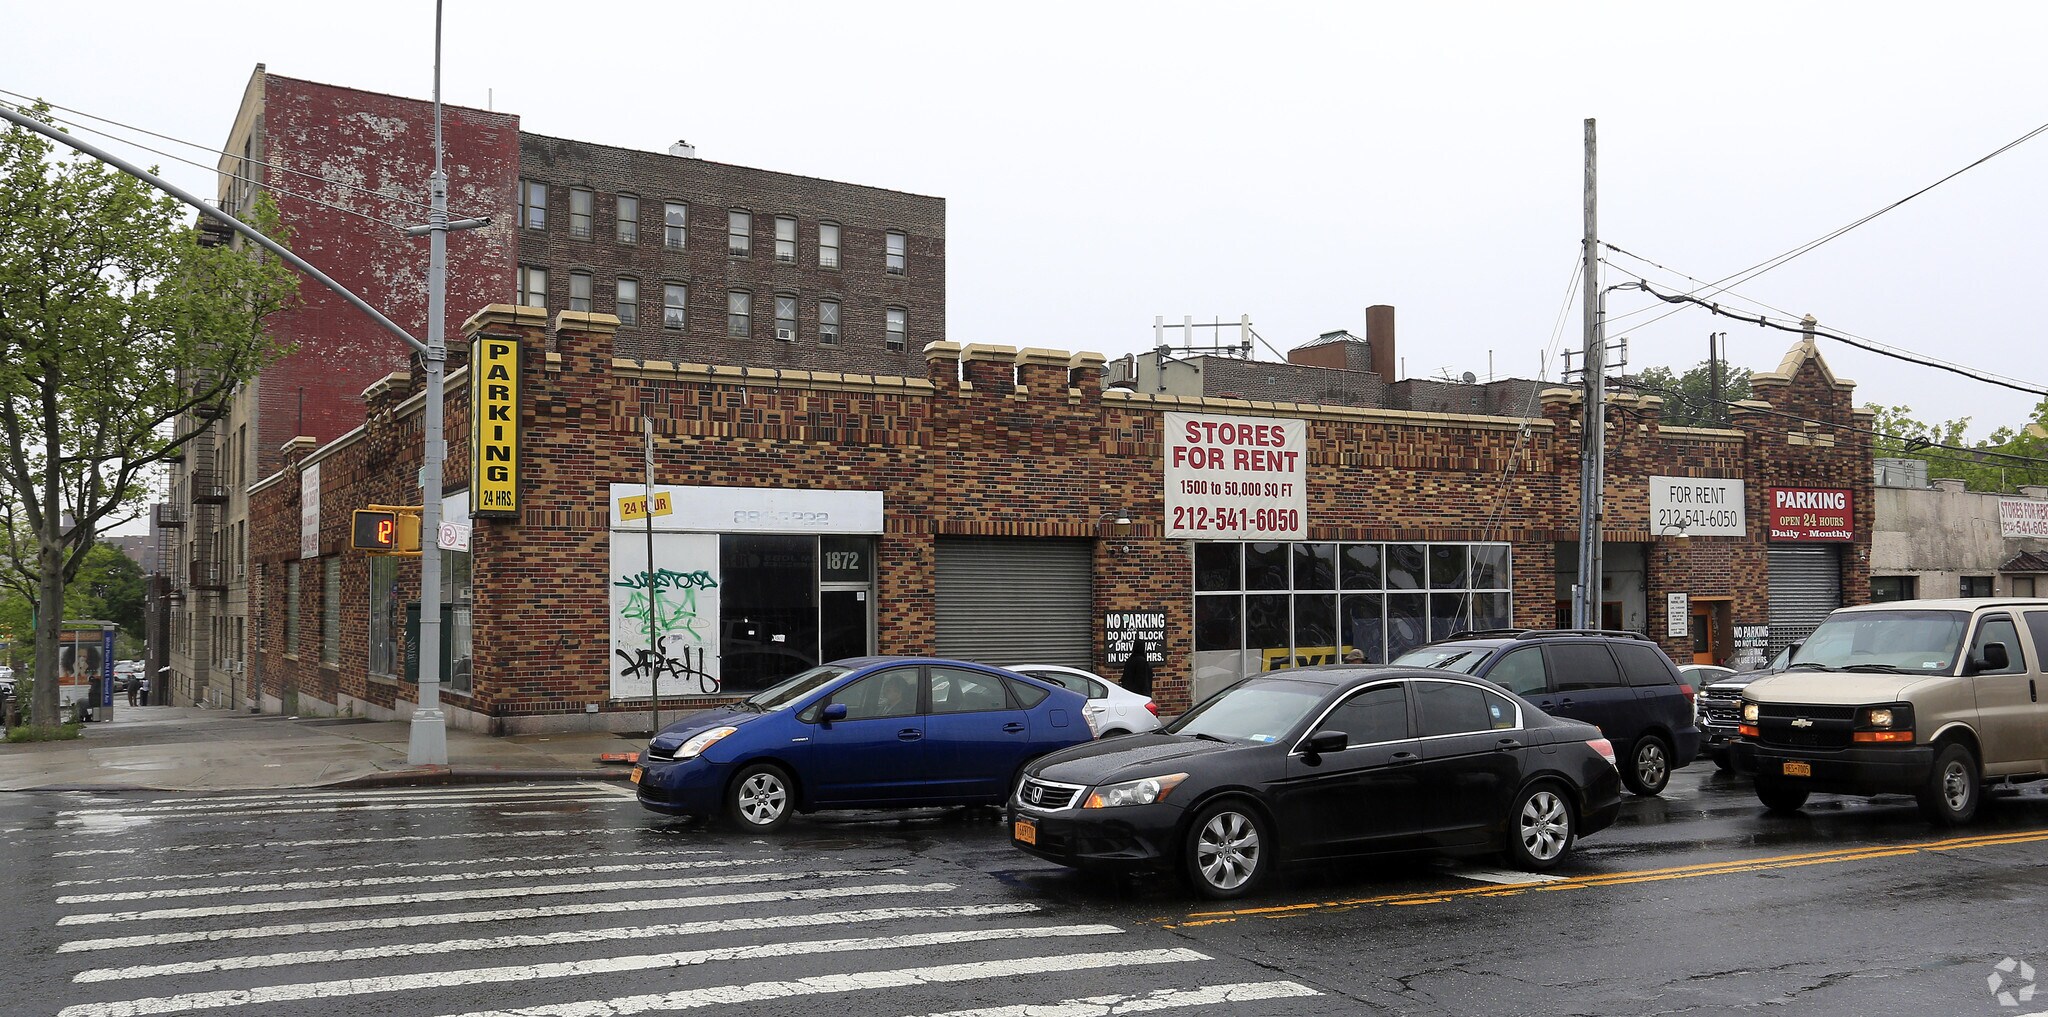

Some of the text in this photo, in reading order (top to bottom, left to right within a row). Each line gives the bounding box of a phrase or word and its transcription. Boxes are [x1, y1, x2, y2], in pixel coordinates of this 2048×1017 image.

[485, 343, 512, 482] PARKING
[1185, 420, 1286, 447] STORES
[1172, 446, 1299, 473] FOR RENT
[1180, 479, 1293, 498] 1500 to 50,000 SQ FT
[1669, 485, 1726, 504] FOR RENT
[483, 490, 514, 507] 24 HRS.
[623, 498, 667, 515] 24 HUR
[1775, 490, 1846, 510] PARKING
[1659, 508, 1737, 528] 212541-6050
[2000, 501, 2023, 518] STORES
[1173, 506, 1299, 532] 212-541-6050
[1779, 513, 1844, 527] OPEN 24 HOURS
[378, 520, 392, 544] 12
[1771, 529, 1800, 539] Daily
[1809, 529, 1853, 539] Monthly
[825, 551, 859, 570] 1872
[1106, 613, 1165, 629] NO PARKING
[1107, 631, 1164, 640] DO NOT BLOCK
[1733, 625, 1769, 638] NO PARKING
[1752, 639, 1769, 647] BLOCK
[1107, 652, 1164, 662] IN US HRS.
